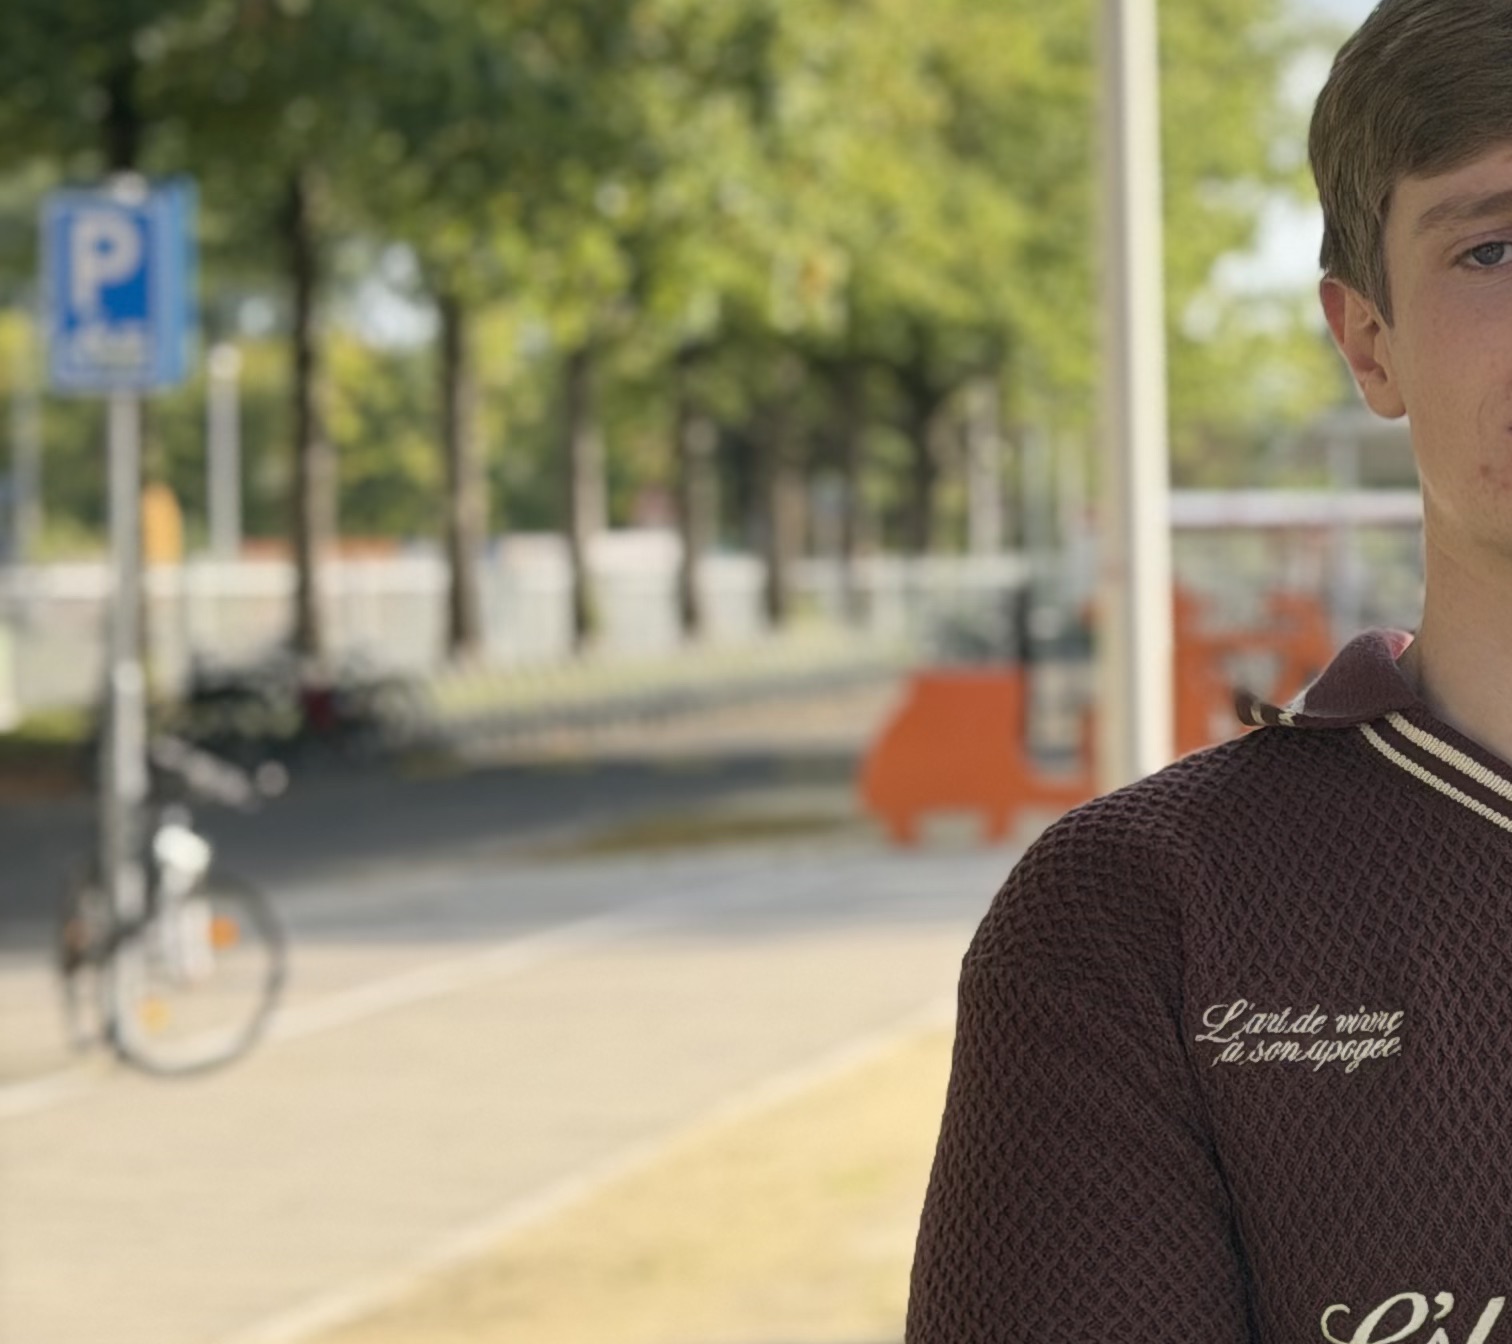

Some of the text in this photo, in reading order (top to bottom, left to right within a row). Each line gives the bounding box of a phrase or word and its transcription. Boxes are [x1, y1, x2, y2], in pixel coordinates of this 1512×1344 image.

[71, 210, 141, 313] P
[1195, 999, 1404, 1043] L'art de vivre
[1241, 1039, 1302, 1065] son
